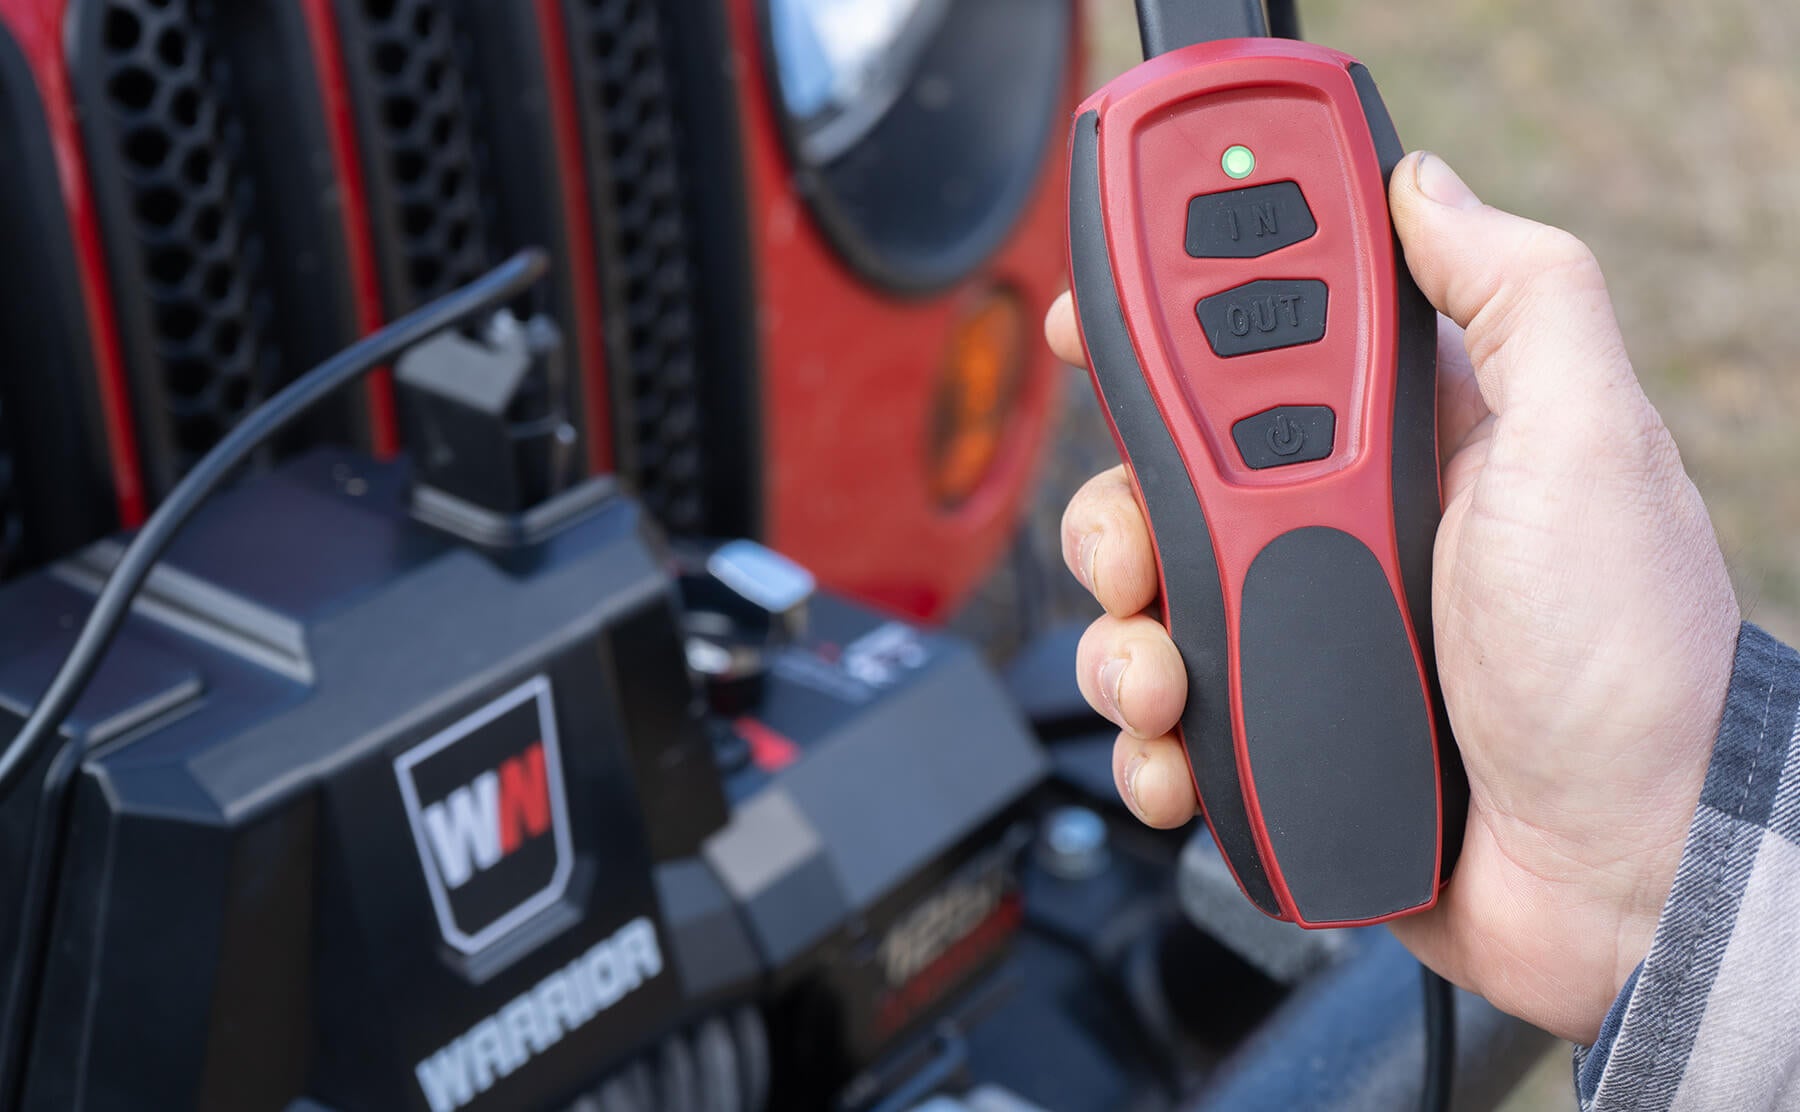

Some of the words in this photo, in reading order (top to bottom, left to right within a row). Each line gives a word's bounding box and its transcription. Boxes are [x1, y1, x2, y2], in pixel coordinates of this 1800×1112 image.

[1229, 203, 1278, 240] IN
[1227, 296, 1302, 336] OUT
[415, 917, 663, 1112] WARRIOR
